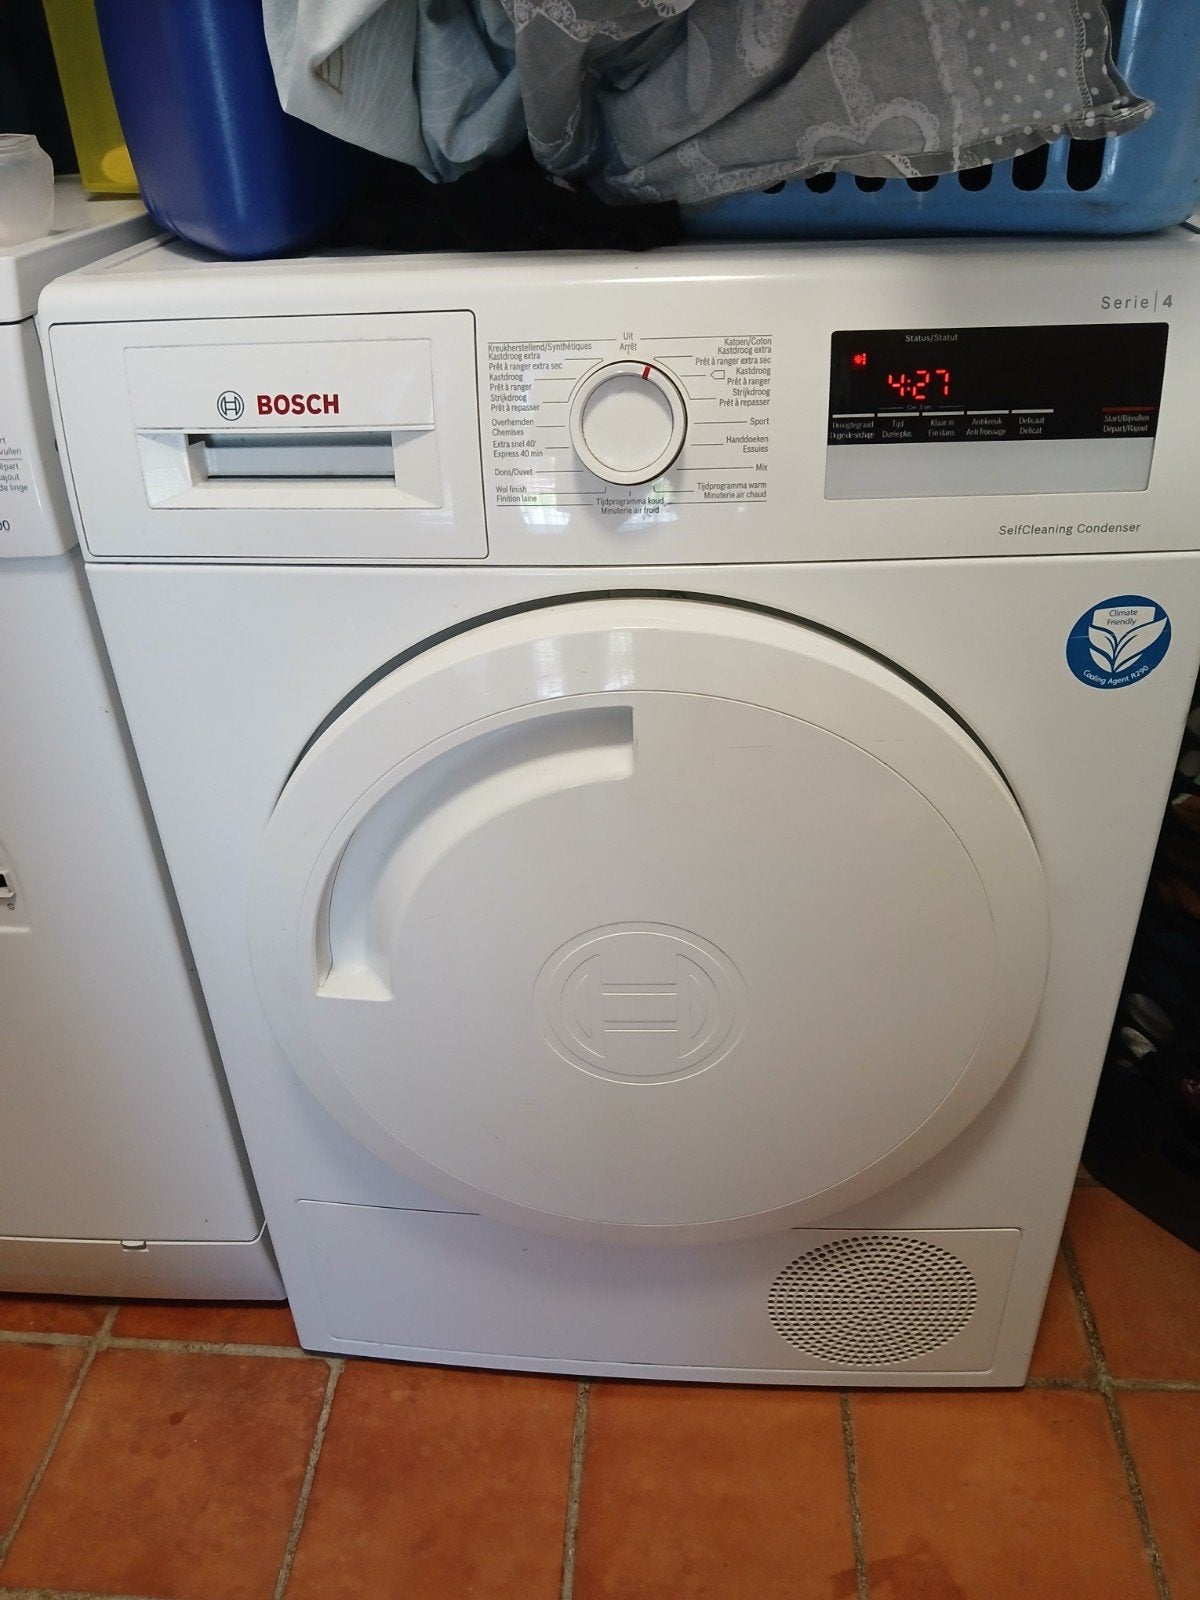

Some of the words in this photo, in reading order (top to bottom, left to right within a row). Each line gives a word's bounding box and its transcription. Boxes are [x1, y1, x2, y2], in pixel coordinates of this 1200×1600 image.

[623, 331, 633, 340] Uit
[905, 333, 958, 342] Status/Statut
[724, 337, 772, 346] Katoen/Coton
[488, 342, 592, 352] Kreukherstellend/Synthétiques
[717, 346, 752, 355] Kastdroog
[488, 352, 522, 361] Kastdroog
[695, 357, 710, 365] Prêt
[711, 357, 715, 365] à
[488, 362, 503, 370] Prêt
[735, 366, 771, 375] Kastdroog
[489, 373, 523, 382] Kastdroog
[748, 378, 770, 386] ranger
[510, 384, 532, 392] ranger
[887, 369, 949, 400] 4:27
[732, 387, 770, 396] Strijkdroog
[490, 393, 527, 402] Strijkdroog
[256, 393, 339, 415] BOSCH
[490, 403, 506, 411] Prêt
[719, 398, 734, 406] Prêt
[740, 398, 770, 407] repasser
[749, 417, 769, 426] Sport
[726, 435, 768, 443] Handdoeken
[742, 445, 768, 453] Essuies
[493, 450, 519, 458] Express
[494, 468, 533, 476] Dons/Duvet
[697, 482, 747, 490] Tijdprogramma
[596, 497, 646, 506] Tijdprogramma
[998, 524, 1073, 536] SelfCleaning
[1076, 522, 1141, 533] Condenser
[1106, 618, 1137, 626] Friendly
[1082, 669, 1106, 685] Cooling
[1107, 675, 1130, 685] Agent
[1130, 665, 1149, 679] R290
